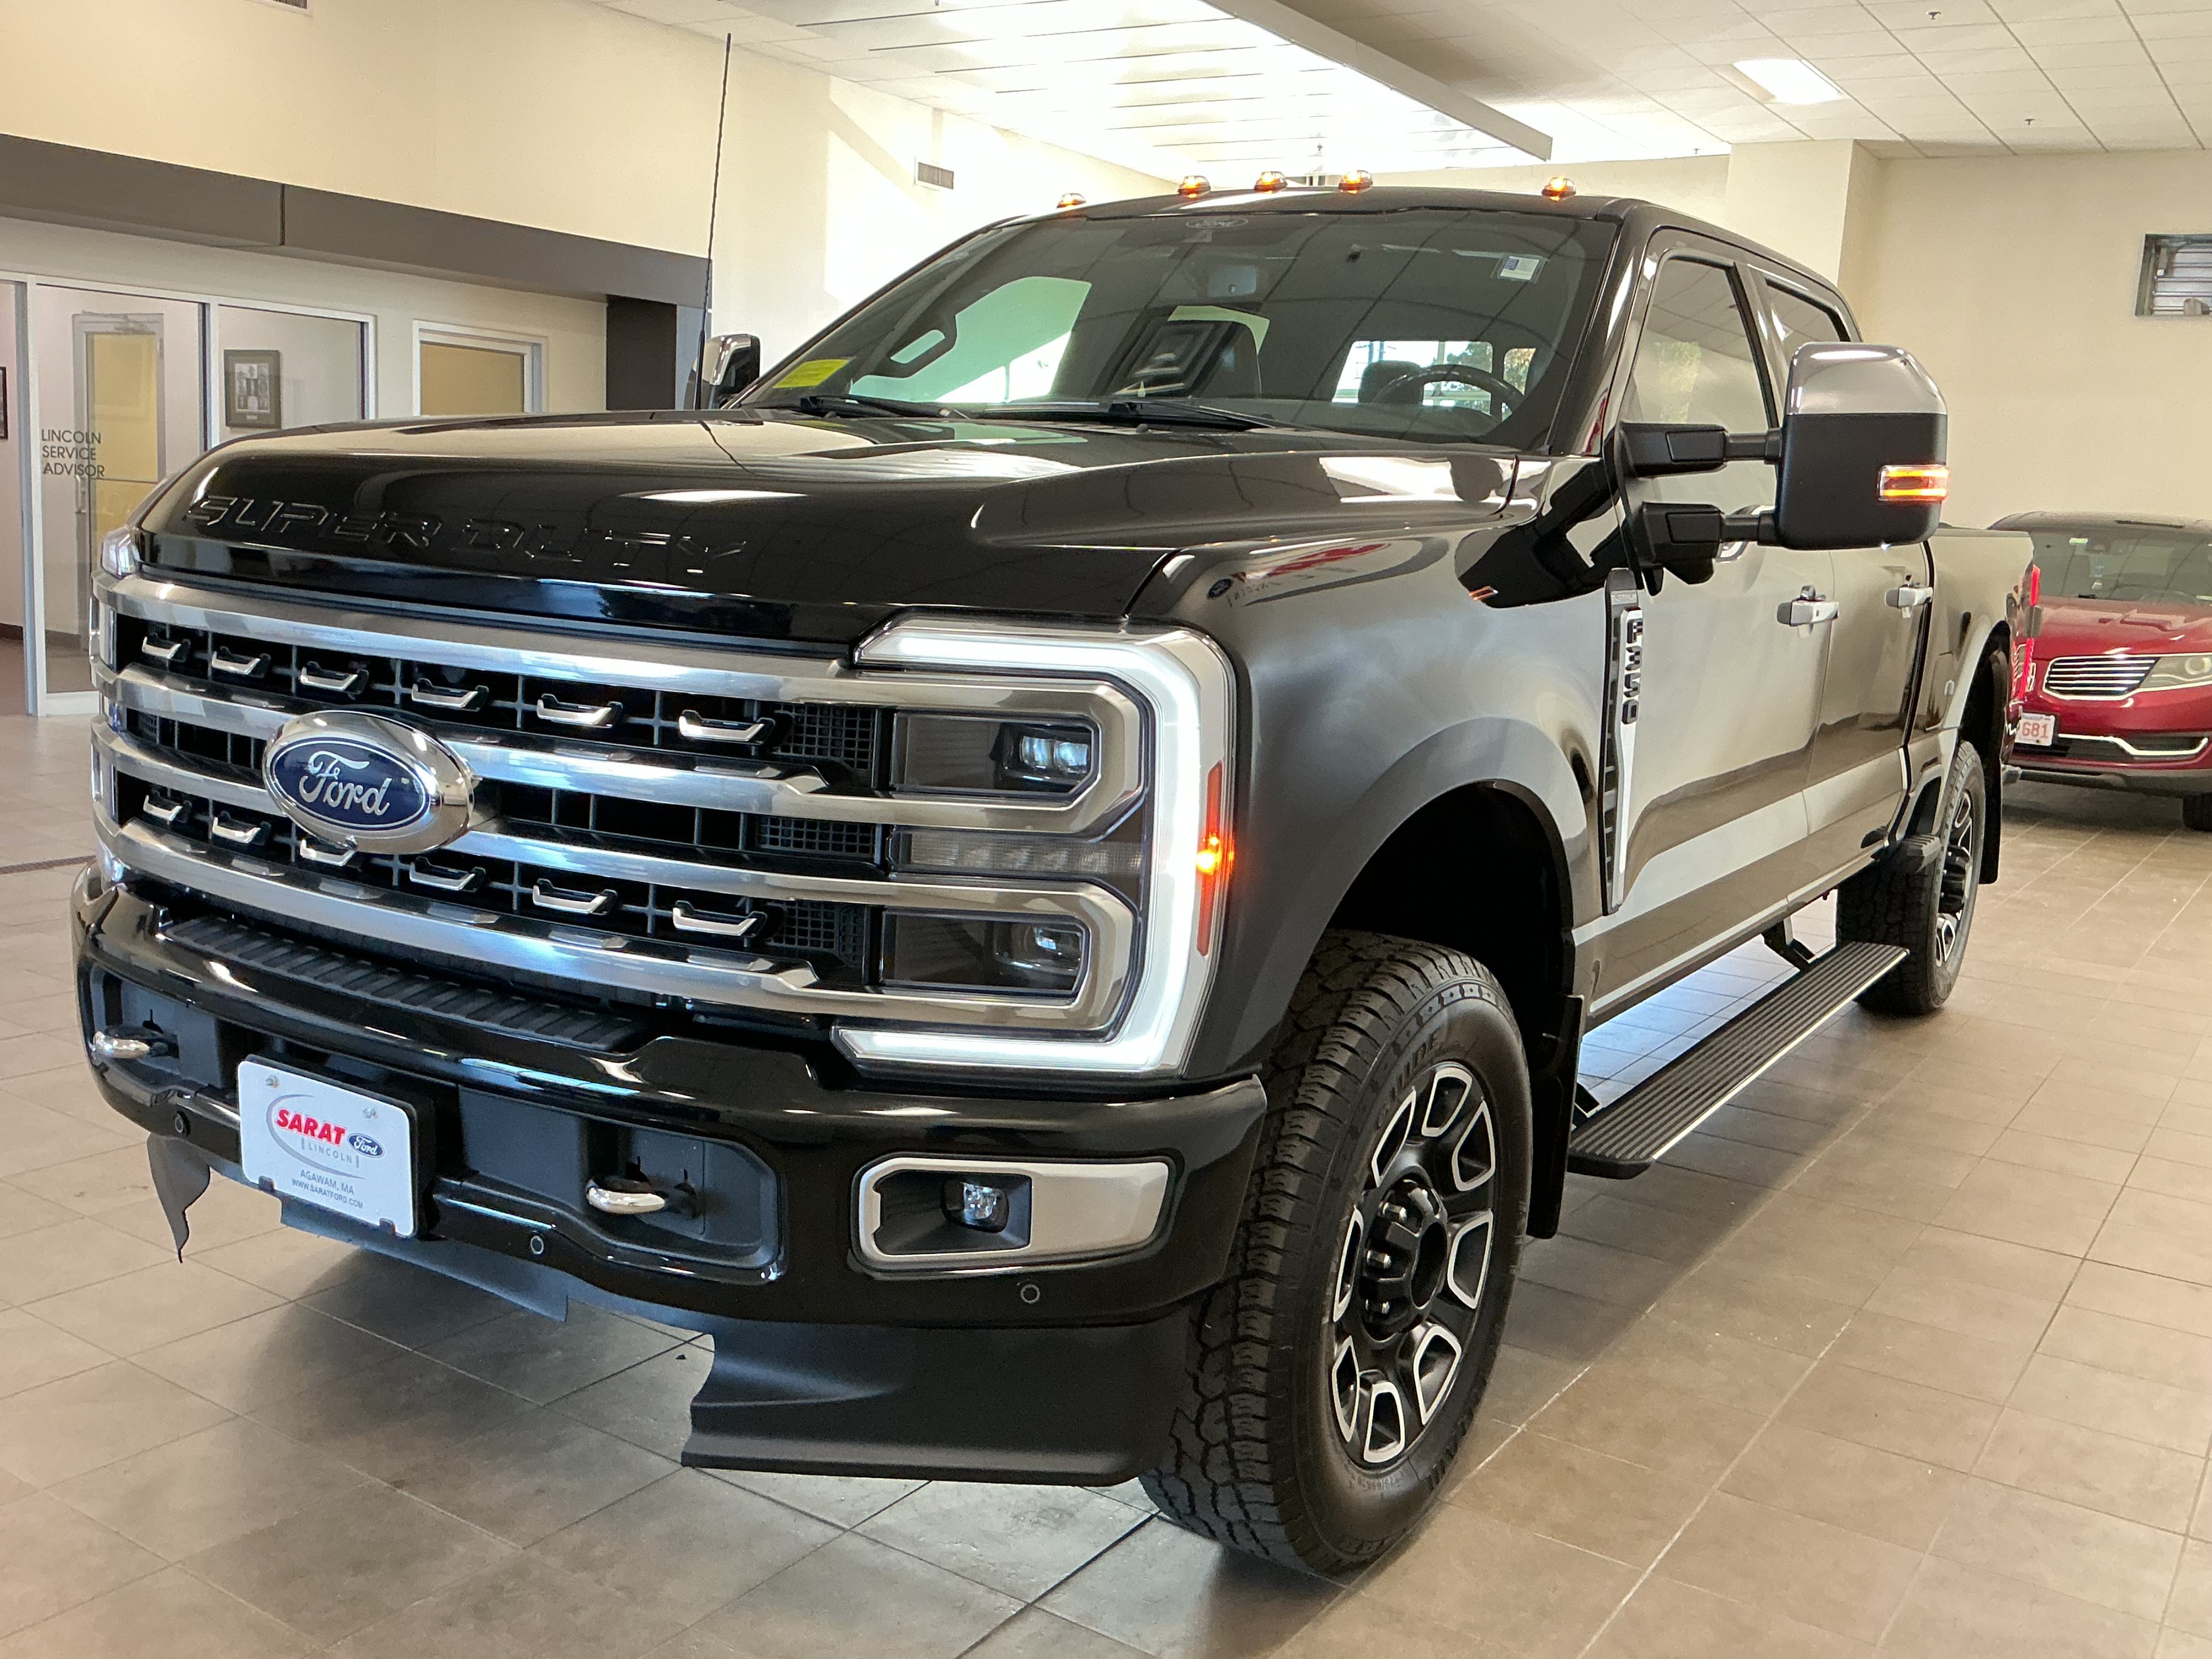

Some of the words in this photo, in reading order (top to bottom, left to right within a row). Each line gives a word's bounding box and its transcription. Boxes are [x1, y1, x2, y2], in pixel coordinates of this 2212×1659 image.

[41, 429, 101, 444] LINCOLN
[42, 445, 96, 460] SERVICE
[43, 462, 105, 477] ADVISOR
[182, 495, 442, 548] SUPER
[1621, 618, 1644, 725] F350
[298, 750, 393, 816] Ford
[276, 1109, 346, 1145] SARAT
[309, 1142, 353, 1163] LINCOLN
[353, 1136, 378, 1155] Ford
[291, 1178, 364, 1209] WWW.SARATFORD.COM
[300, 1169, 339, 1191] AGAWAM,
[341, 1183, 354, 1195] MA
